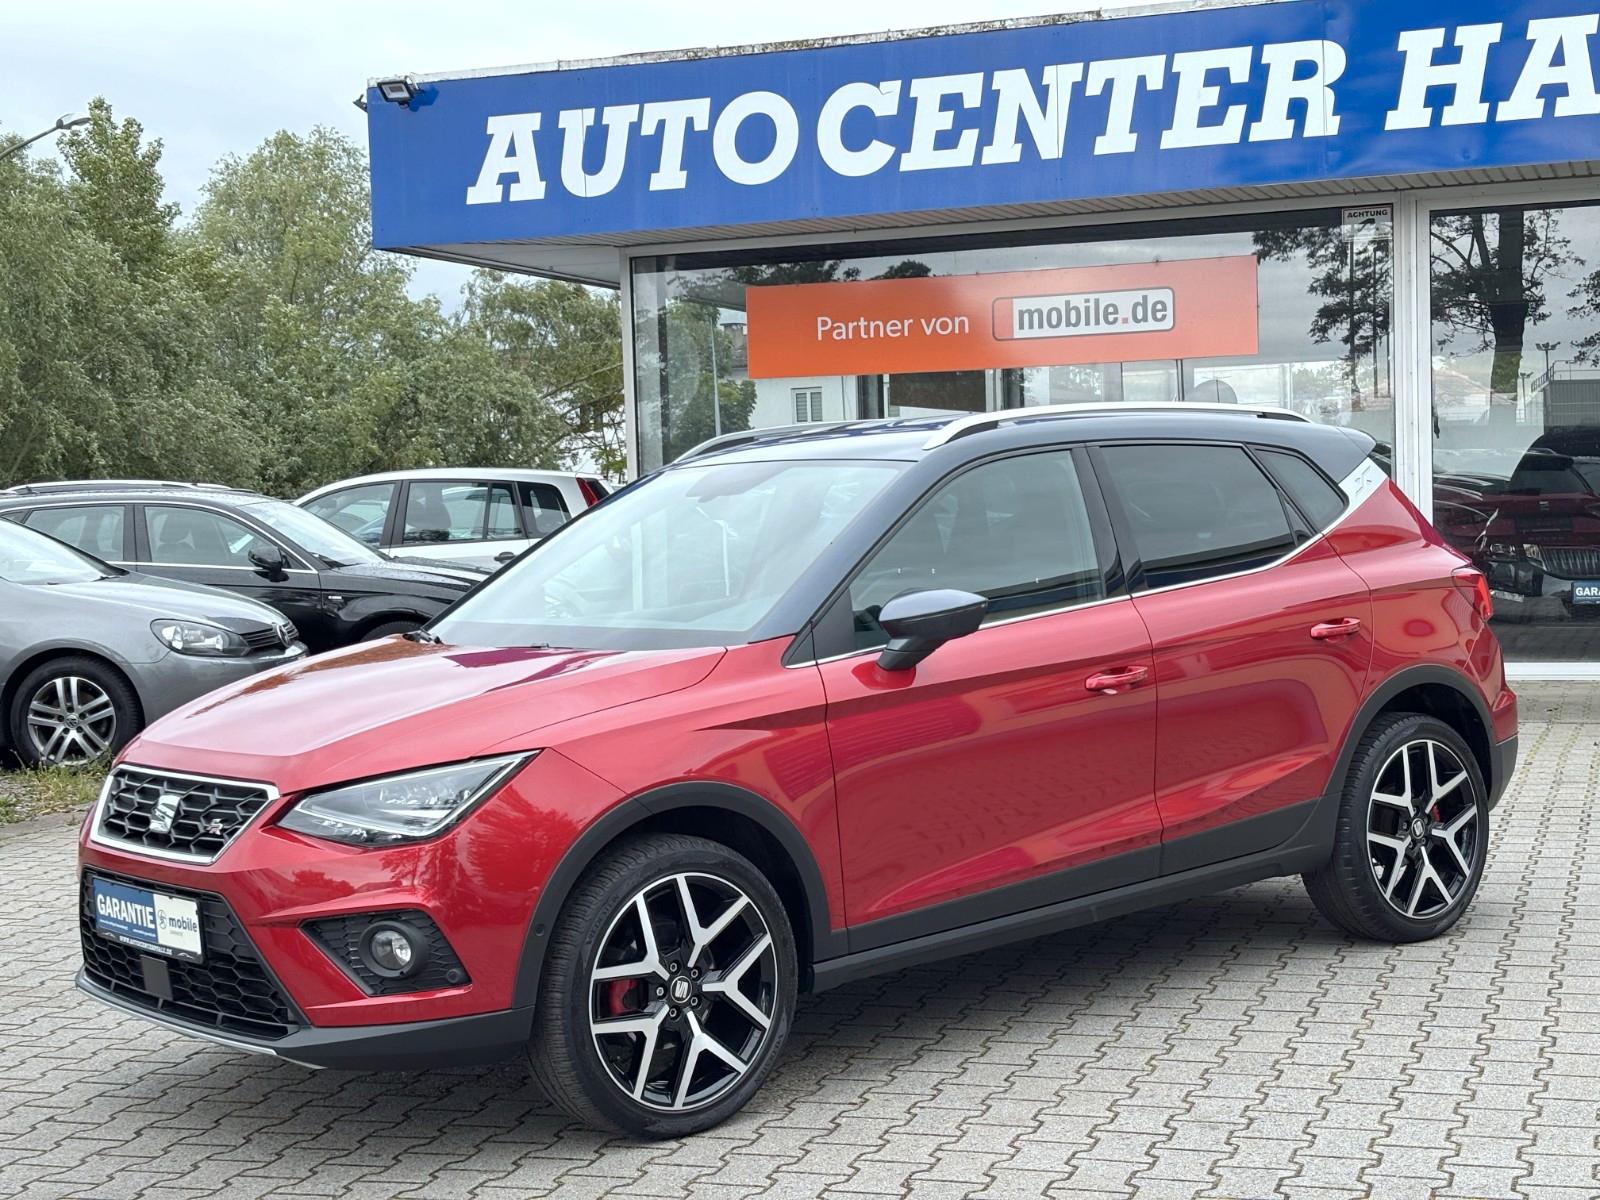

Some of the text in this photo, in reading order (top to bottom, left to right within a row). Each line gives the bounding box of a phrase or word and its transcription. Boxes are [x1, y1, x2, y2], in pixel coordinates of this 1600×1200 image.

[1346, 209, 1388, 218] ACHTUNG
[816, 295, 1168, 341] Partner von mobile.de
[1575, 586, 1600, 596] GAR
[97, 893, 155, 928] GARANTIE
[168, 916, 198, 932] mobile
